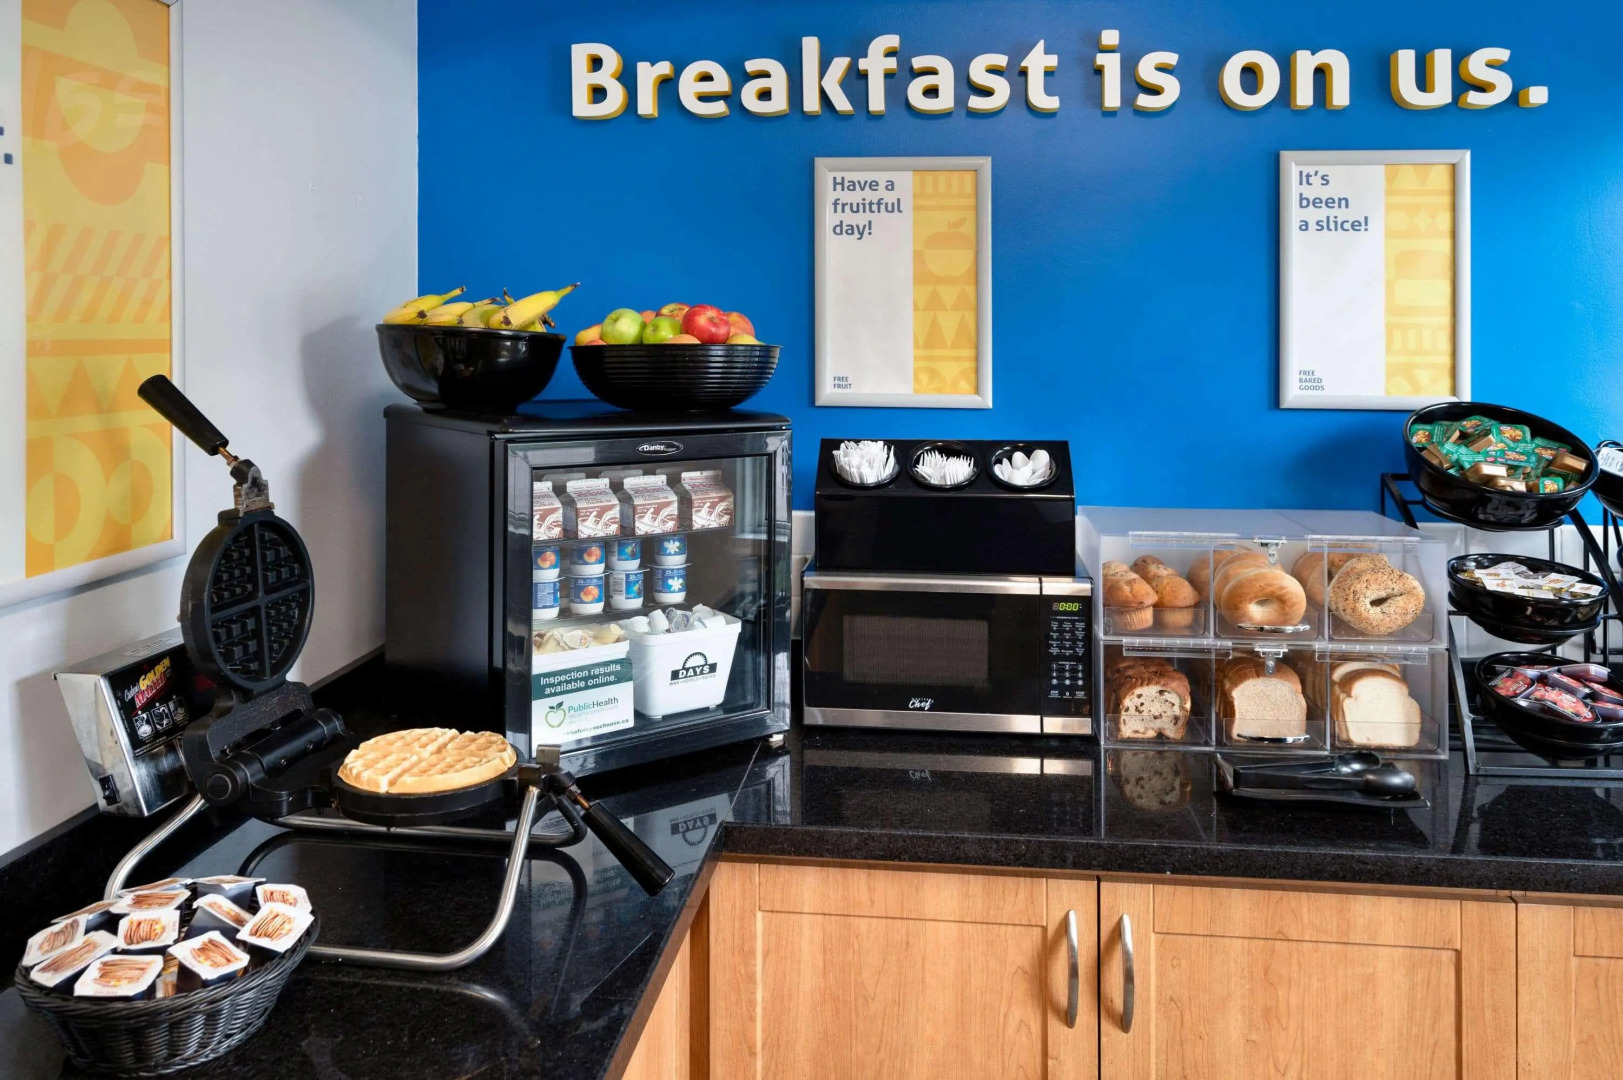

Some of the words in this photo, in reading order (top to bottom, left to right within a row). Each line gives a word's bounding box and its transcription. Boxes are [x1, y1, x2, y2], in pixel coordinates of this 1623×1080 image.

[571, 34, 1060, 120] Breakfast
[1094, 29, 1181, 112] is
[1218, 49, 1350, 111] on
[1390, 46, 1549, 110] us.
[832, 176, 880, 192] Have
[885, 179, 895, 192] a
[1299, 170, 1330, 186] It's
[832, 198, 903, 214] fruitful
[1299, 193, 1349, 209] been
[832, 220, 873, 241] day!
[1298, 219, 1309, 232] a
[1315, 215, 1369, 232] slice!
[1299, 369, 1316, 377] FREE
[540, 669, 589, 686] Inspection
[591, 663, 621, 675] results
[678, 664, 710, 679] DAYS
[544, 680, 586, 695] available
[587, 674, 618, 686] online.
[567, 697, 619, 714] PublicHealth
[908, 698, 932, 711] Chef
